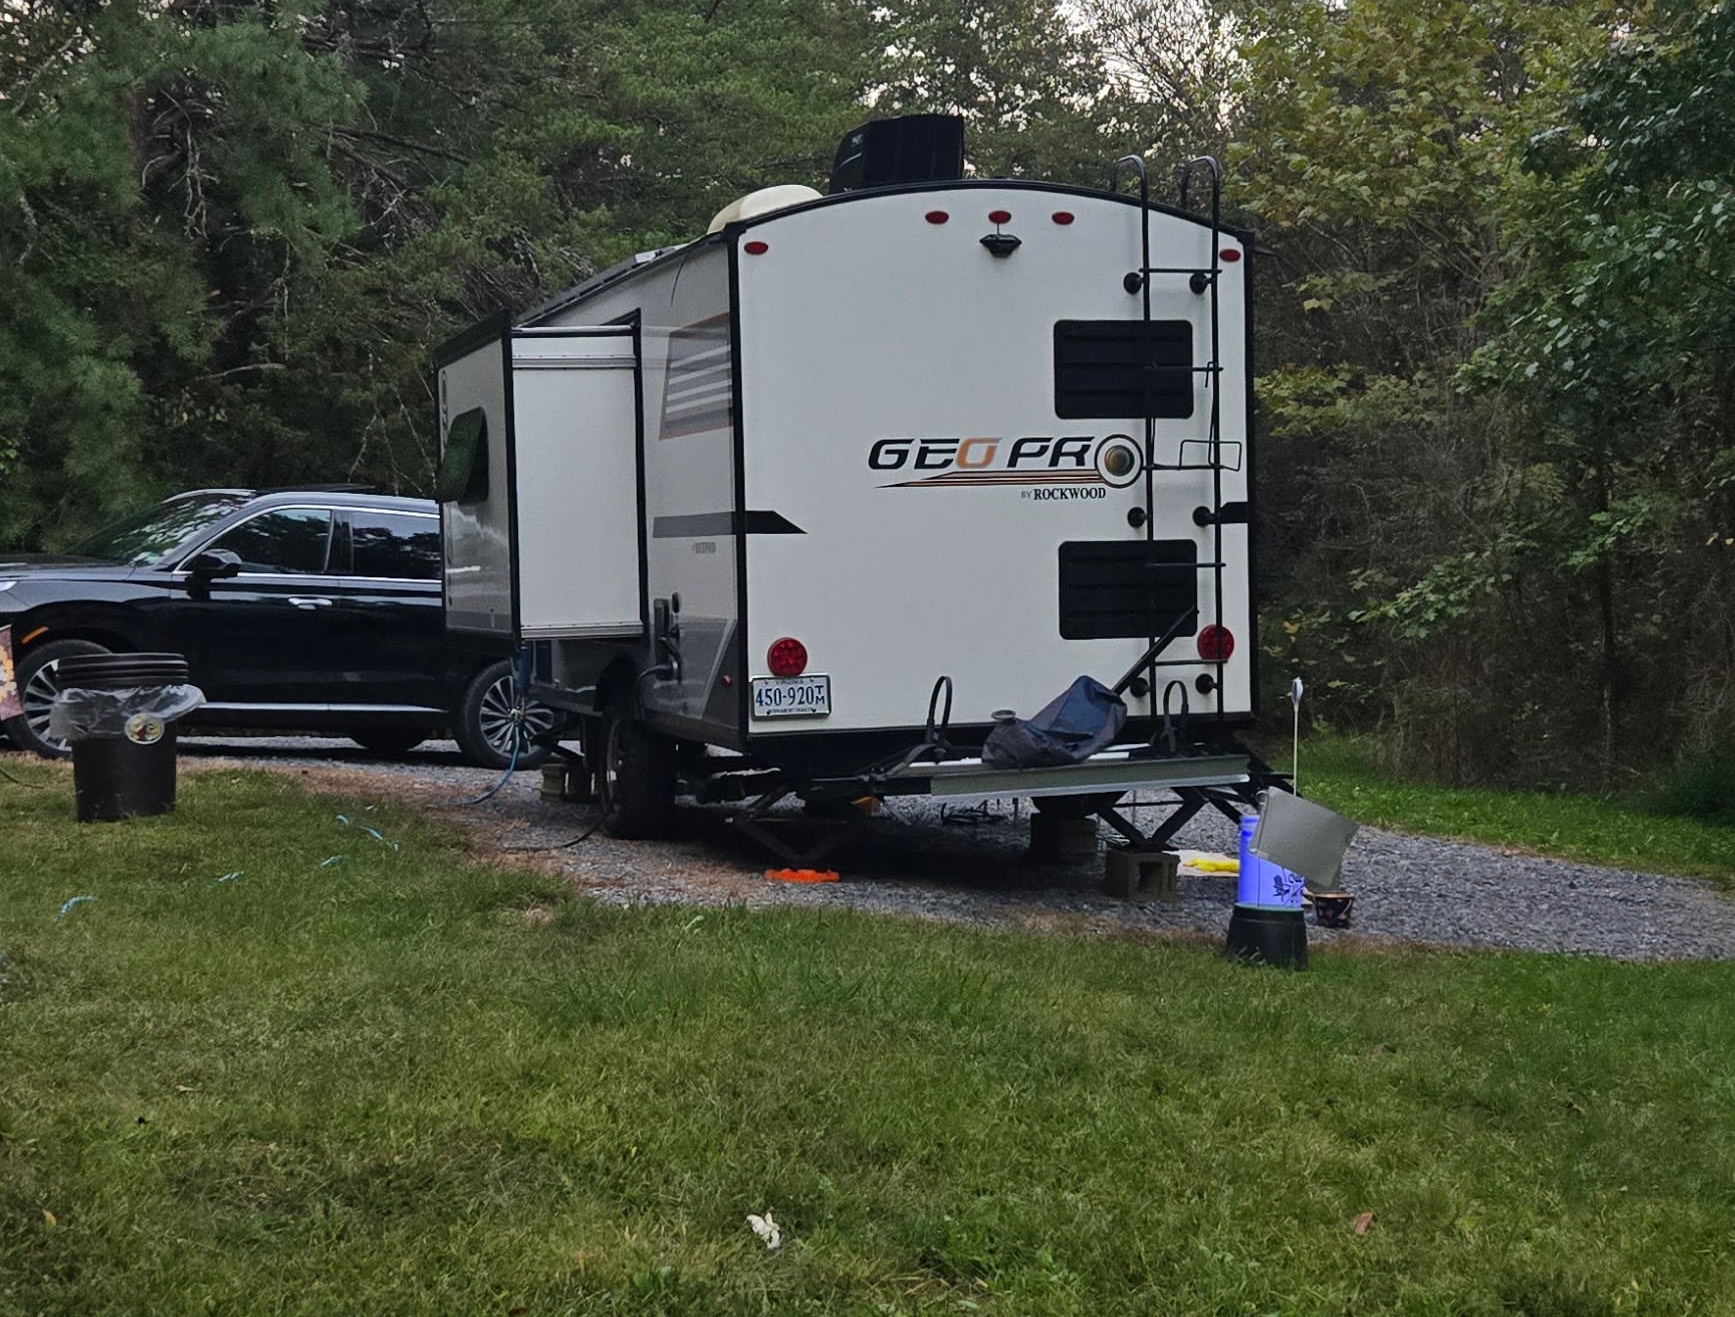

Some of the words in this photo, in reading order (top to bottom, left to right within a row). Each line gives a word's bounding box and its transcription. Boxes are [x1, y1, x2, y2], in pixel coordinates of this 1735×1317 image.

[868, 437, 1002, 470] GEO
[1021, 491, 1032, 499] BY
[1034, 488, 1107, 500] ROCKWOOD
[755, 686, 814, 707] 450-920
